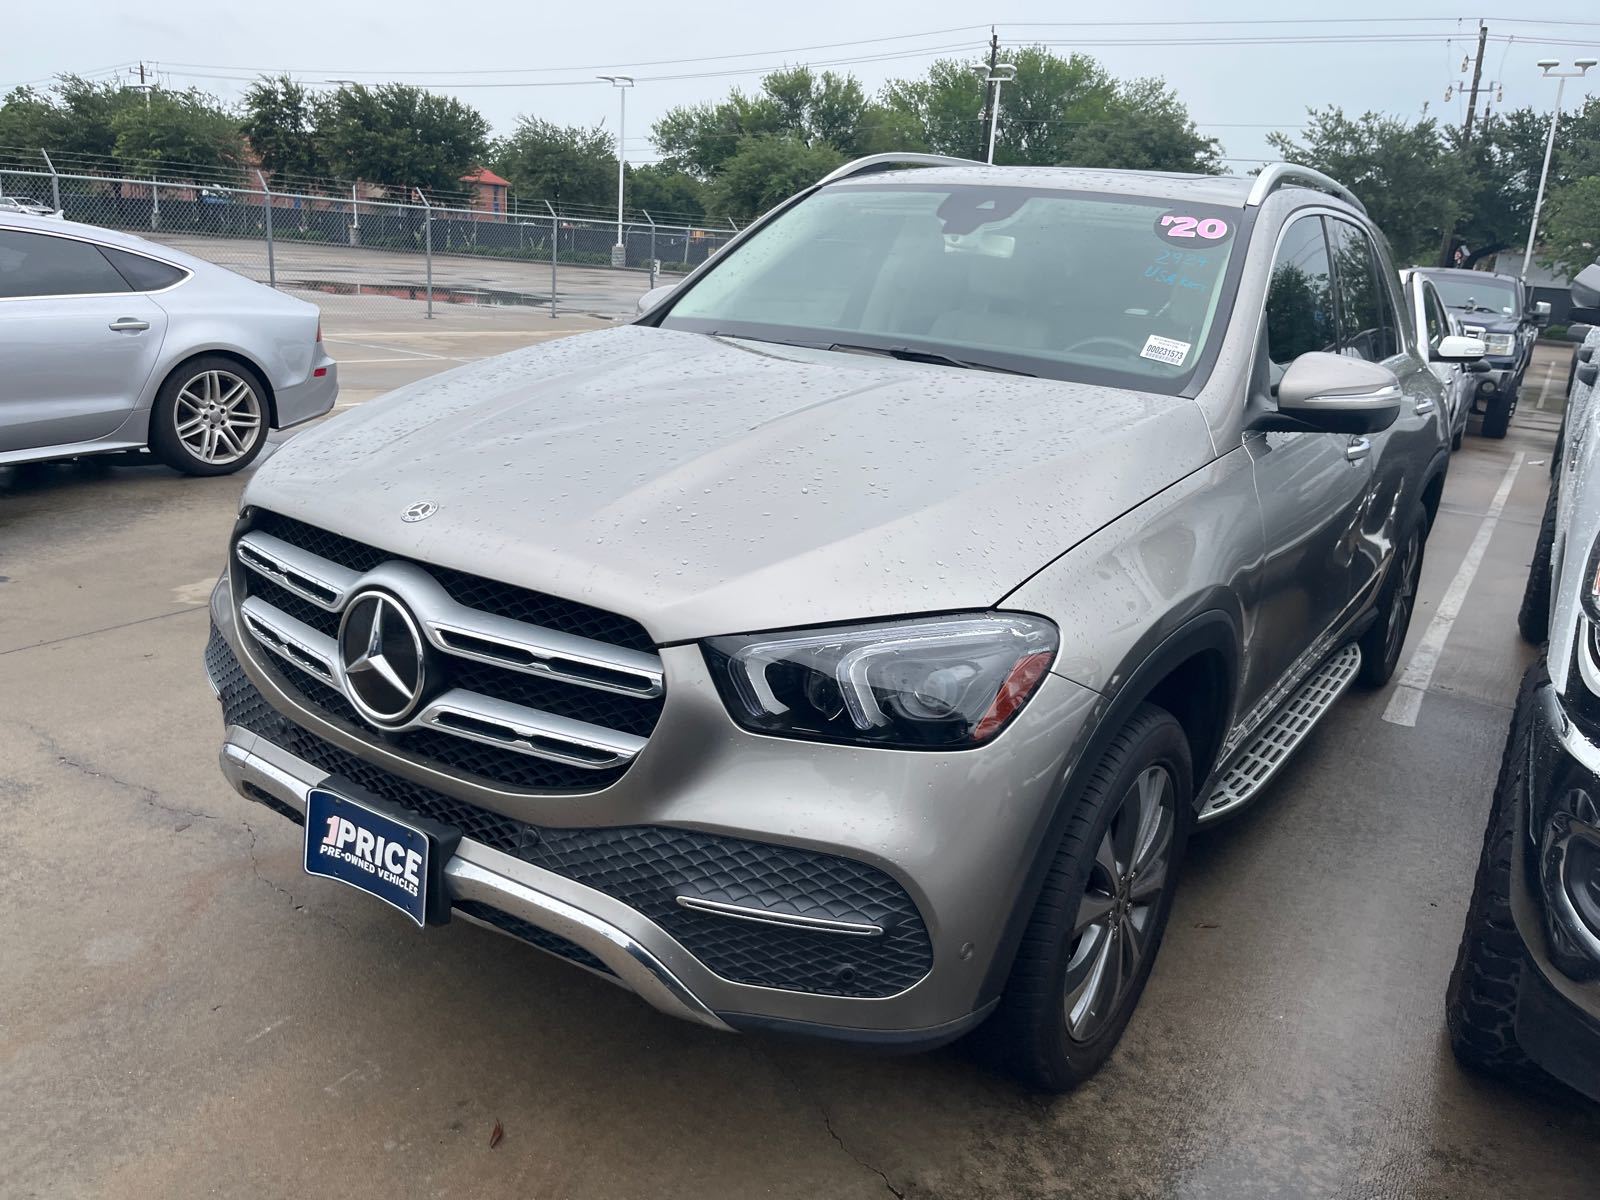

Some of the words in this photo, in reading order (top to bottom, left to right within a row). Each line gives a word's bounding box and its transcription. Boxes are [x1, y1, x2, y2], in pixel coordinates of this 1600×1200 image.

[1161, 215, 1227, 239] '20
[1147, 344, 1184, 360] 000231573
[319, 844, 376, 875] PRE-OWNED
[377, 867, 419, 897] VEHICLES
